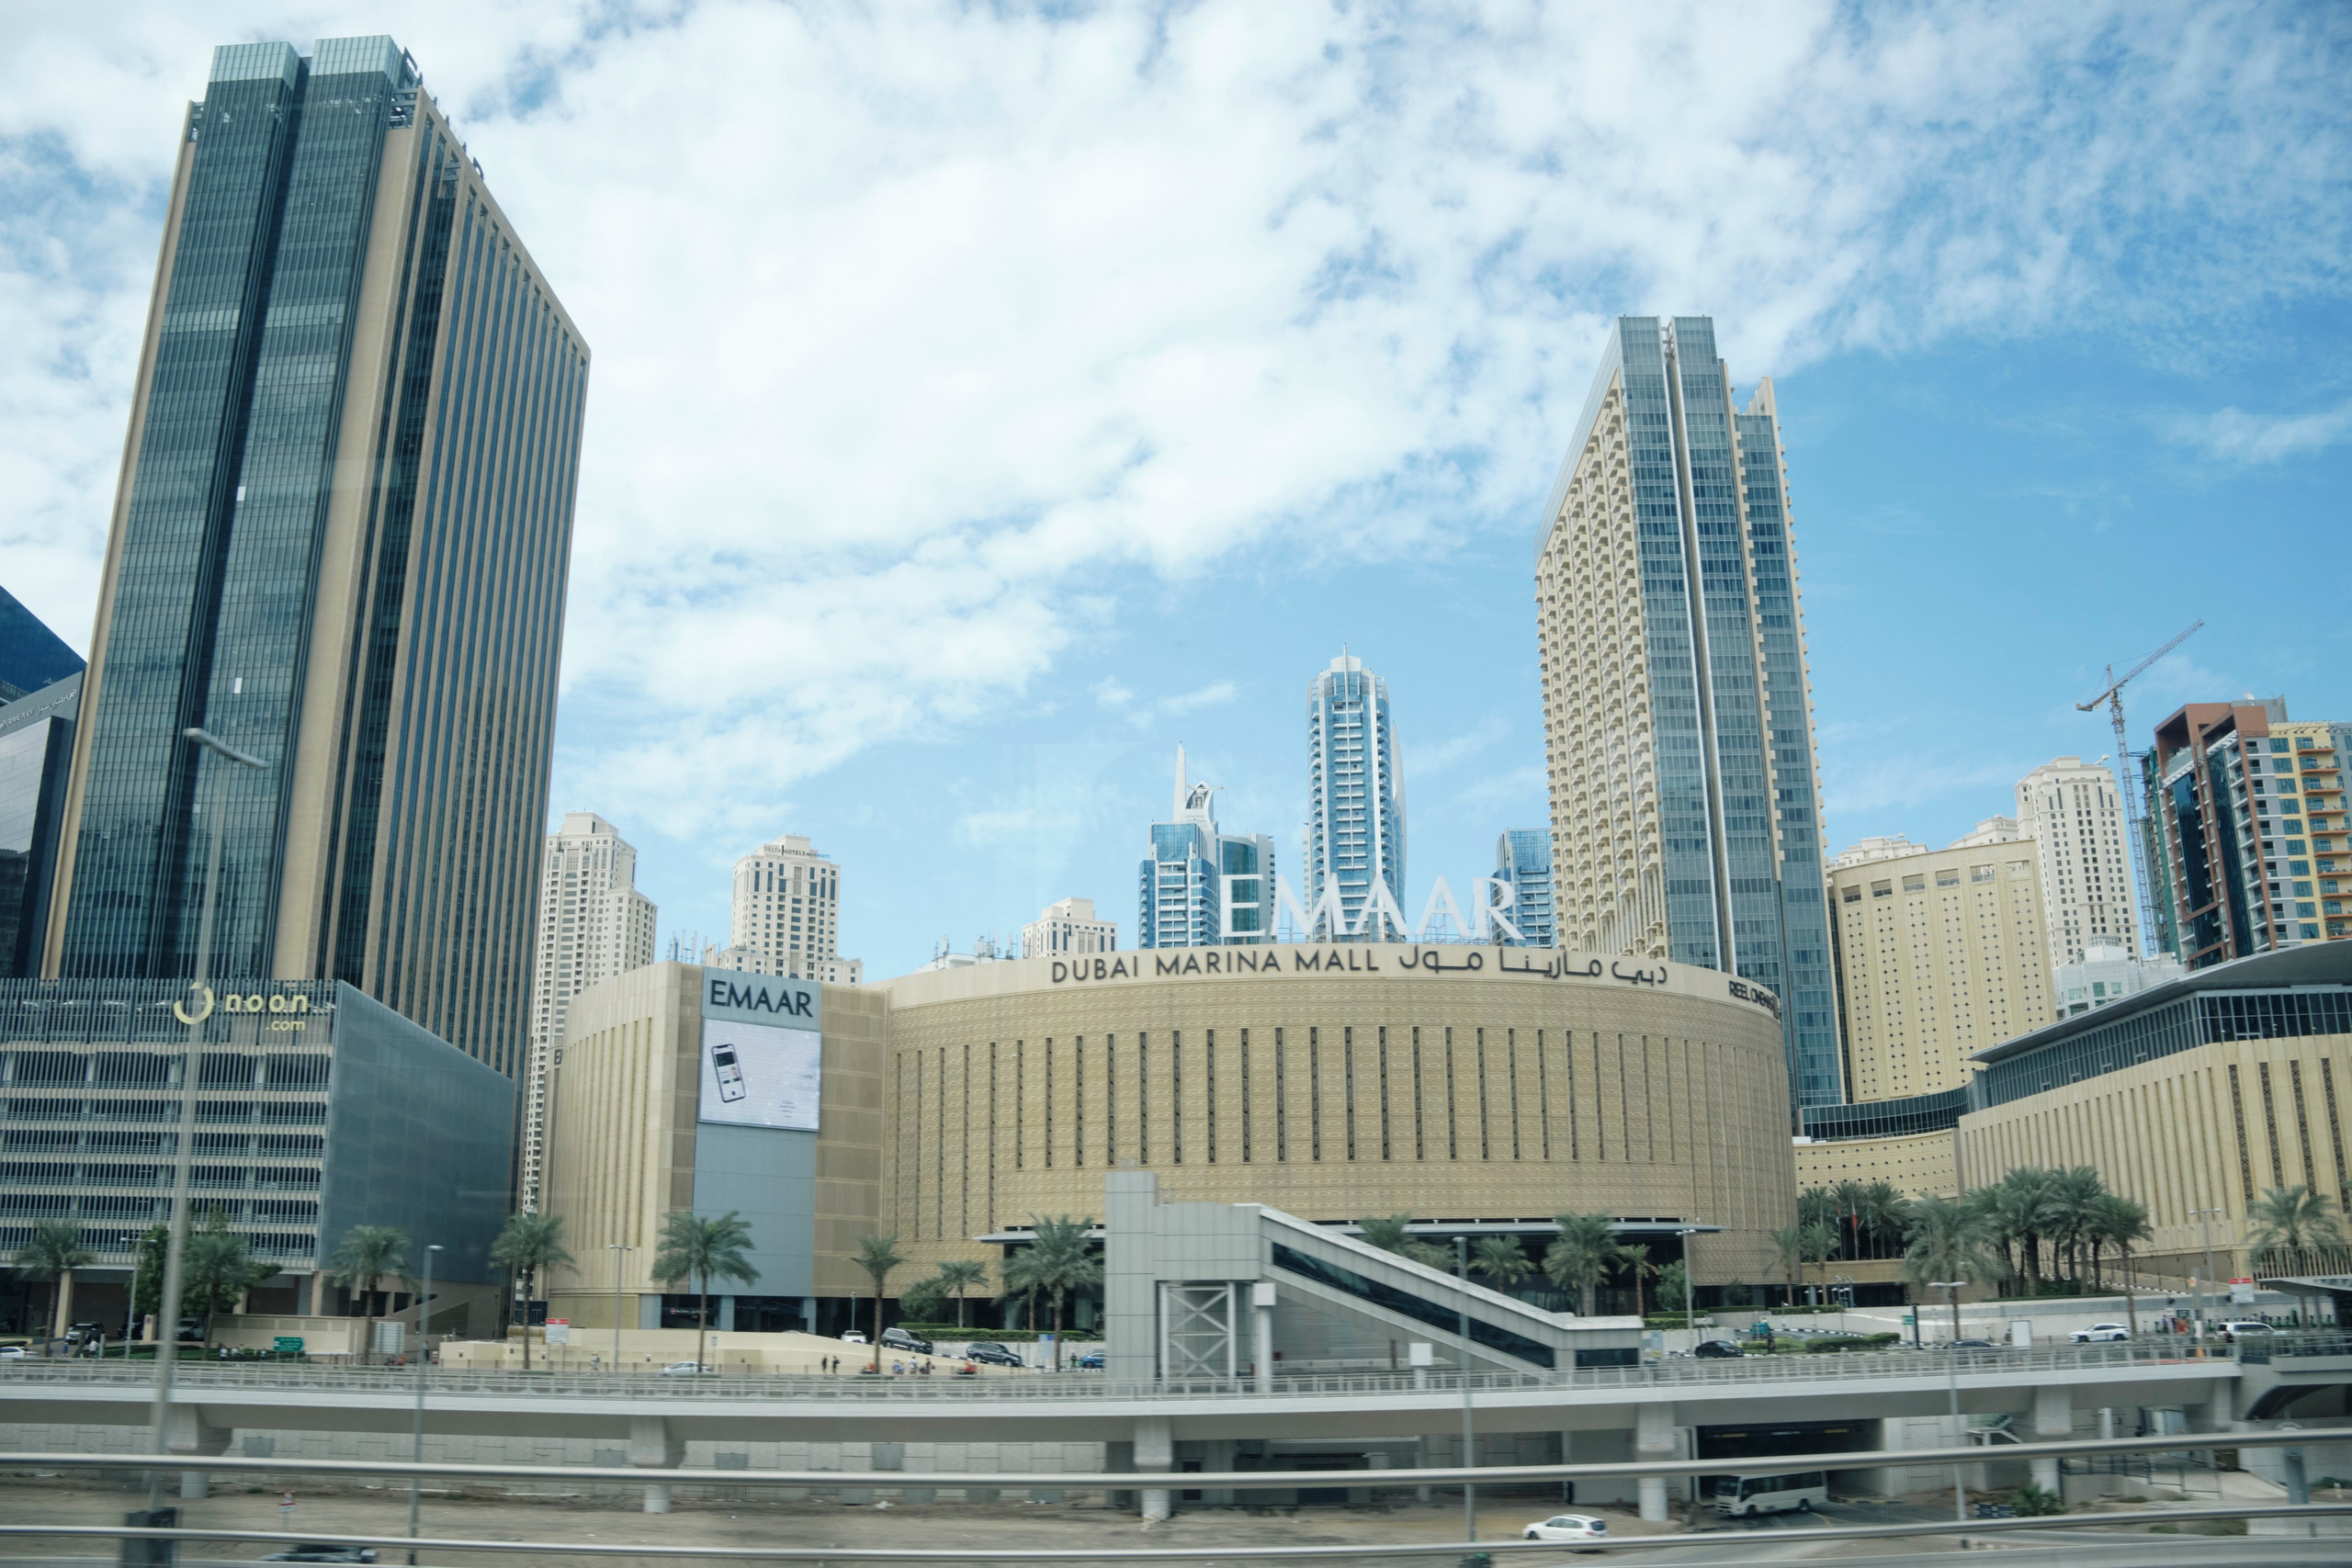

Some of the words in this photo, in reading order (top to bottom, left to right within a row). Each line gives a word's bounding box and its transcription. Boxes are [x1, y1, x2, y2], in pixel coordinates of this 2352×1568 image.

[1217, 873, 1526, 940] EMAAR
[1051, 954, 1138, 984] DUBAI
[1156, 949, 1282, 976] MARINA
[1295, 948, 1380, 972] MALL
[1398, 945, 1484, 971] مول
[1498, 946, 1602, 980] مارينا
[1611, 959, 1668, 986] دبي
[224, 993, 309, 1013] noon
[710, 978, 814, 1019] EMAAR
[1728, 980, 1750, 1001] REEL
[265, 1020, 306, 1032] .com
